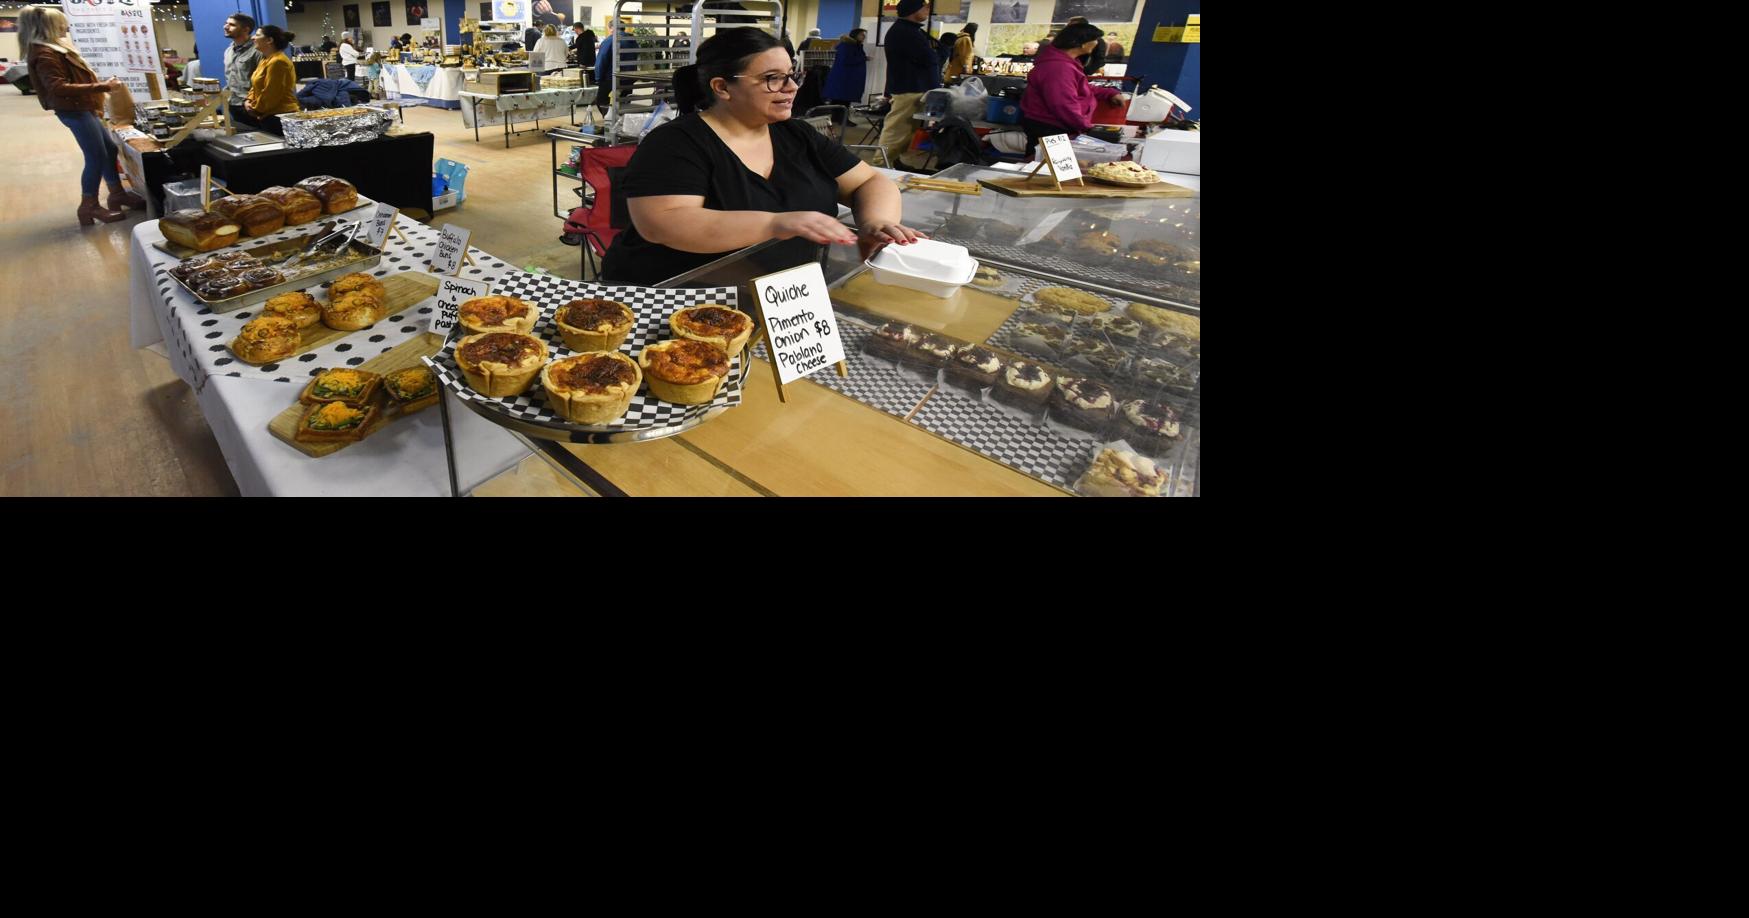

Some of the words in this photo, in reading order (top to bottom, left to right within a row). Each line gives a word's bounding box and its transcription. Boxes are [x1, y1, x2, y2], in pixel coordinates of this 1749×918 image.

[444, 281, 476, 296] Spinach
[765, 284, 809, 307] Quiche
[438, 300, 458, 311] Chees
[768, 309, 815, 333] Pimento
[814, 320, 831, 338] $8
[778, 342, 823, 368] Pablano
